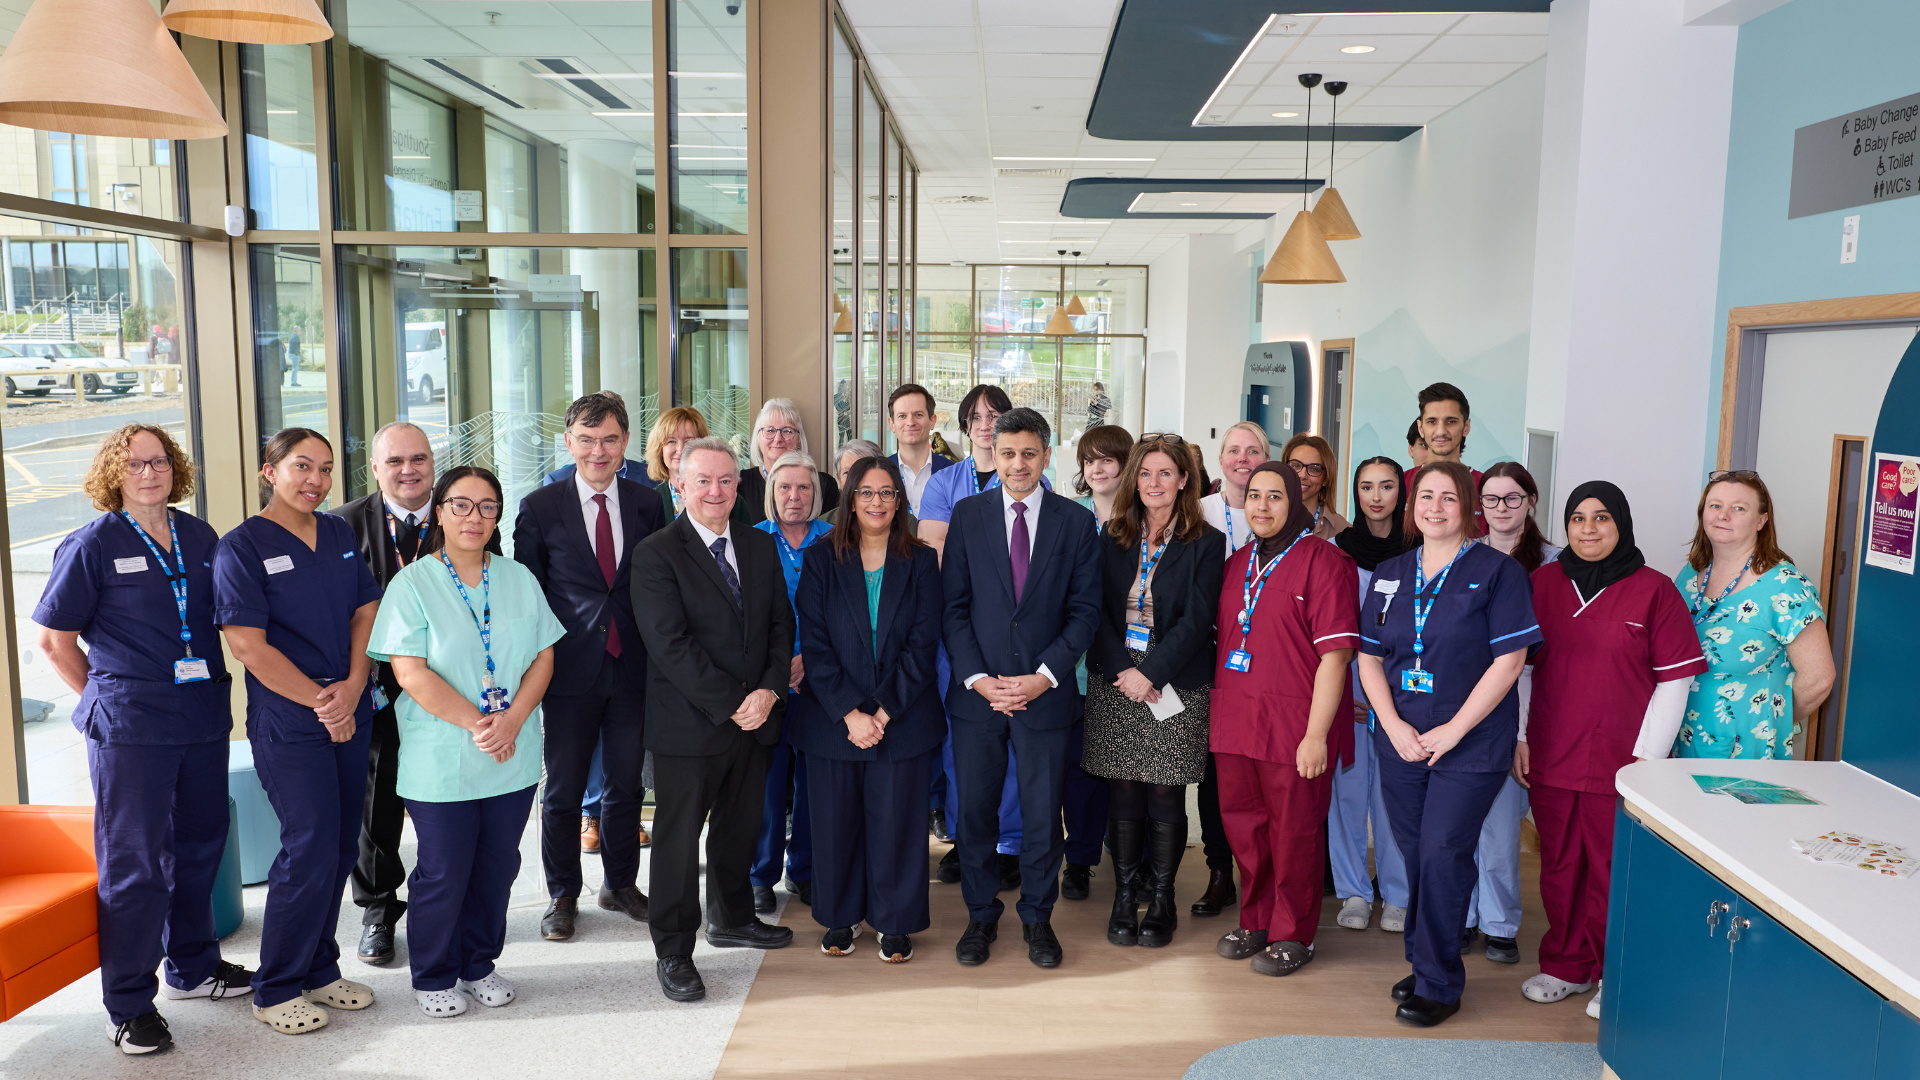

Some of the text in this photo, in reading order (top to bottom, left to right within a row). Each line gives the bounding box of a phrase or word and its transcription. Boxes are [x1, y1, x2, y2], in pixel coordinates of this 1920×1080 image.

[1853, 104, 1919, 132] Baby Change
[1864, 126, 1917, 153] Baby Feed
[1888, 152, 1914, 171] Toilet
[1885, 177, 1911, 195] WC's
[1882, 471, 1898, 482] Good
[1901, 475, 1917, 485] care?
[1902, 466, 1916, 476] Poor
[1881, 481, 1897, 490] care?
[1875, 501, 1915, 519] Tell us now
